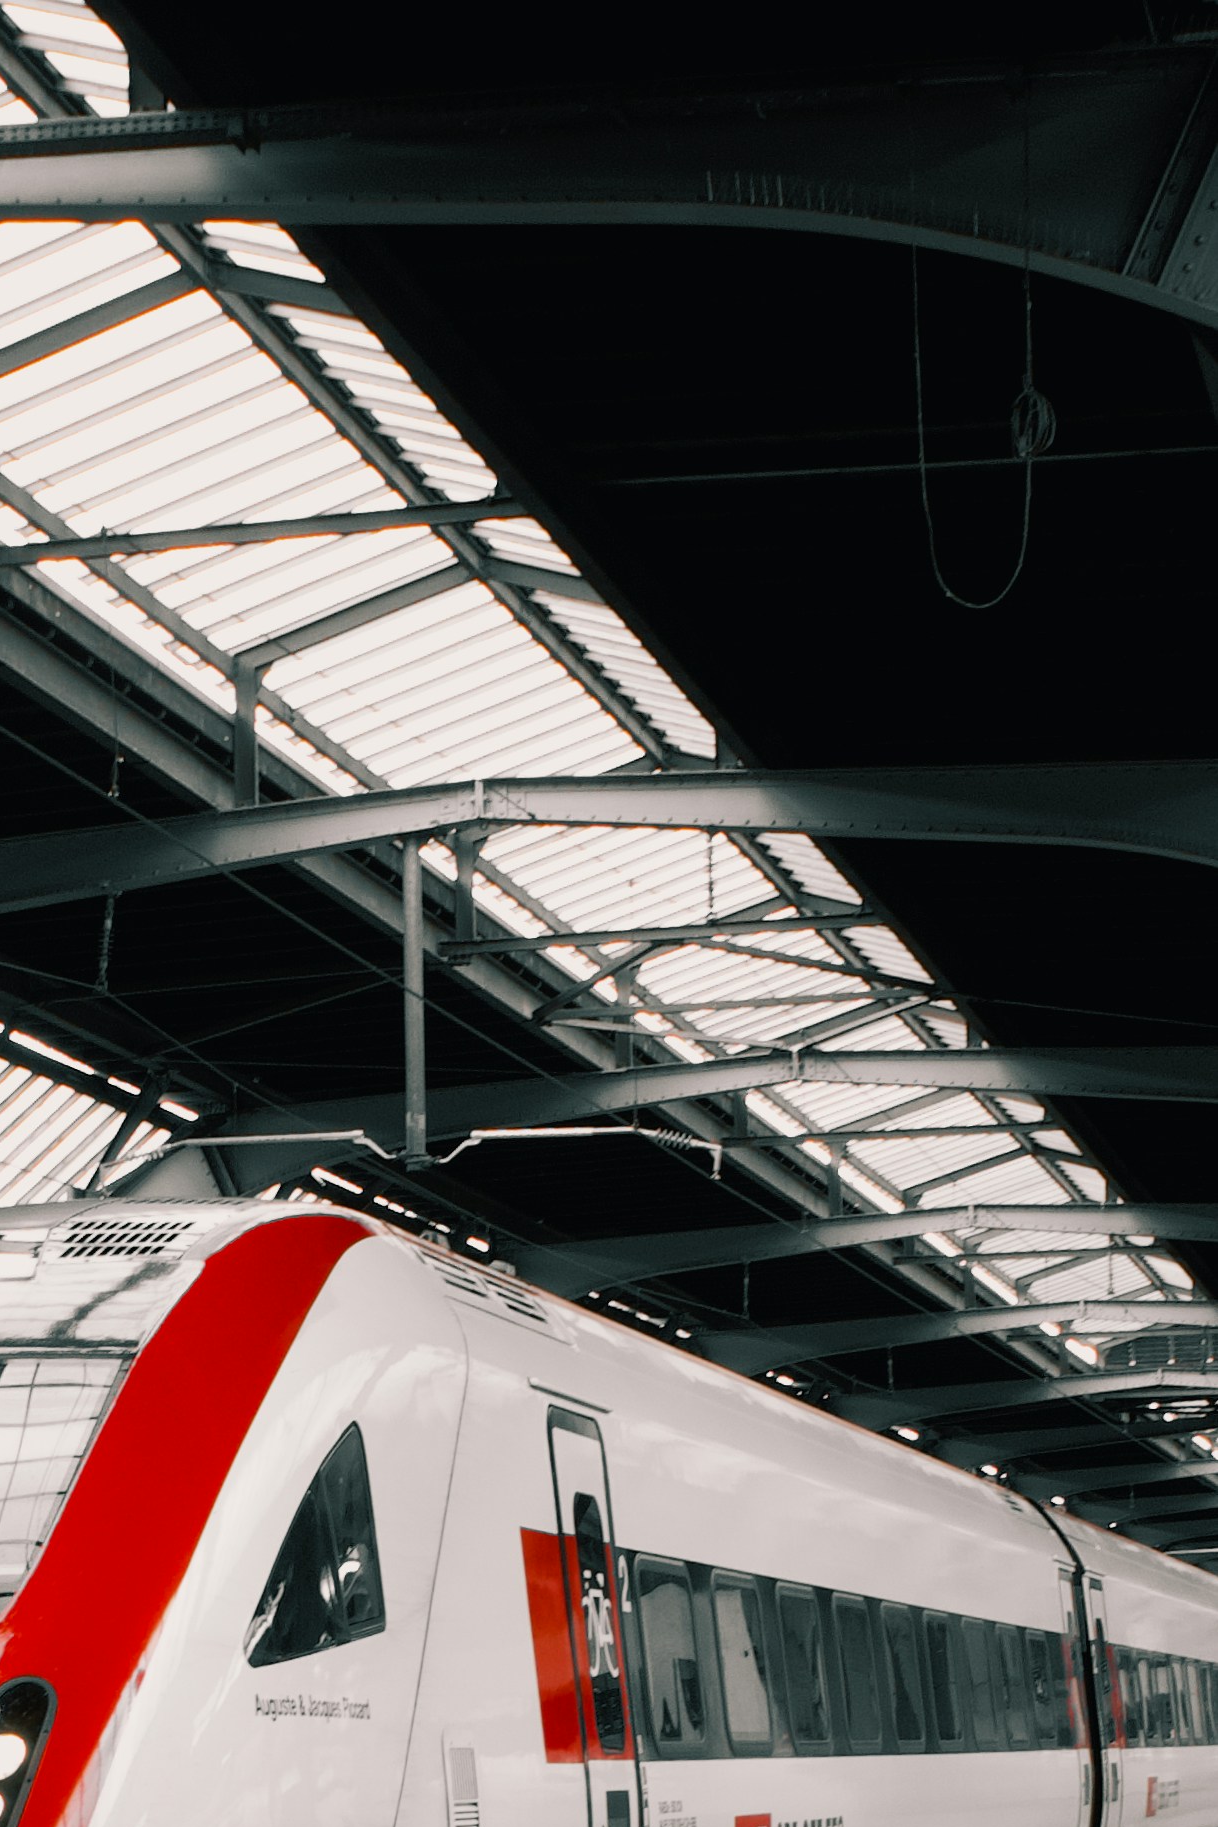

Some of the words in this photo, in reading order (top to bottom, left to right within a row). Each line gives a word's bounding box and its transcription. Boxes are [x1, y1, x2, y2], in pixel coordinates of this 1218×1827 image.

[618, 1554, 632, 1613] 2
[254, 1693, 297, 1722] Auguste
[298, 1694, 306, 1717] &
[307, 1694, 341, 1723] Jacques
